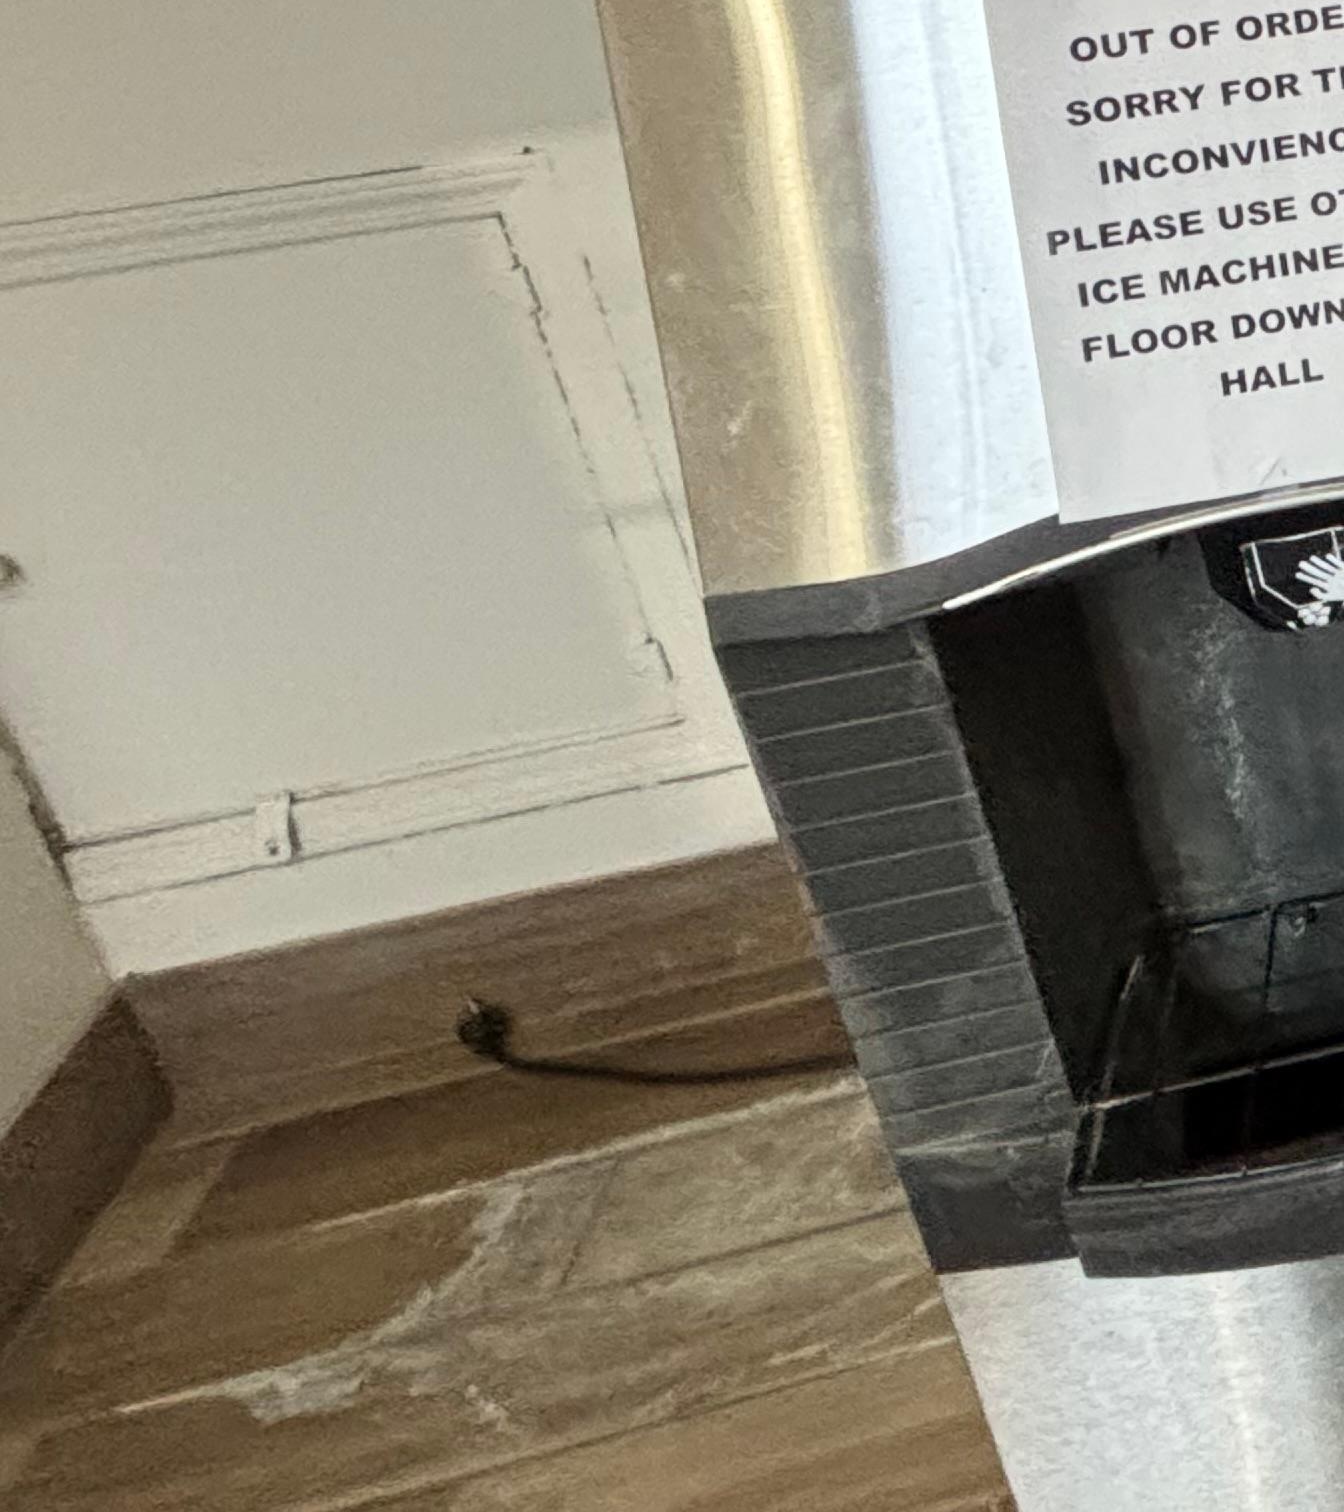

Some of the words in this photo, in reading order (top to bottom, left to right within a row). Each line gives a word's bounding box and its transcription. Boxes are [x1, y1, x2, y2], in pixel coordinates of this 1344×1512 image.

[1070, 28, 1154, 62] OUT
[1170, 20, 1219, 49] OF
[1066, 84, 1204, 126] SORRY
[1220, 73, 1301, 106] FOR
[1047, 210, 1204, 256] PLEASE
[1218, 196, 1297, 230] USE
[1078, 274, 1146, 307] ICE
[1159, 244, 1344, 295] MACHINE
[1082, 320, 1218, 363] FLOOR
[1220, 358, 1324, 396] HALL
